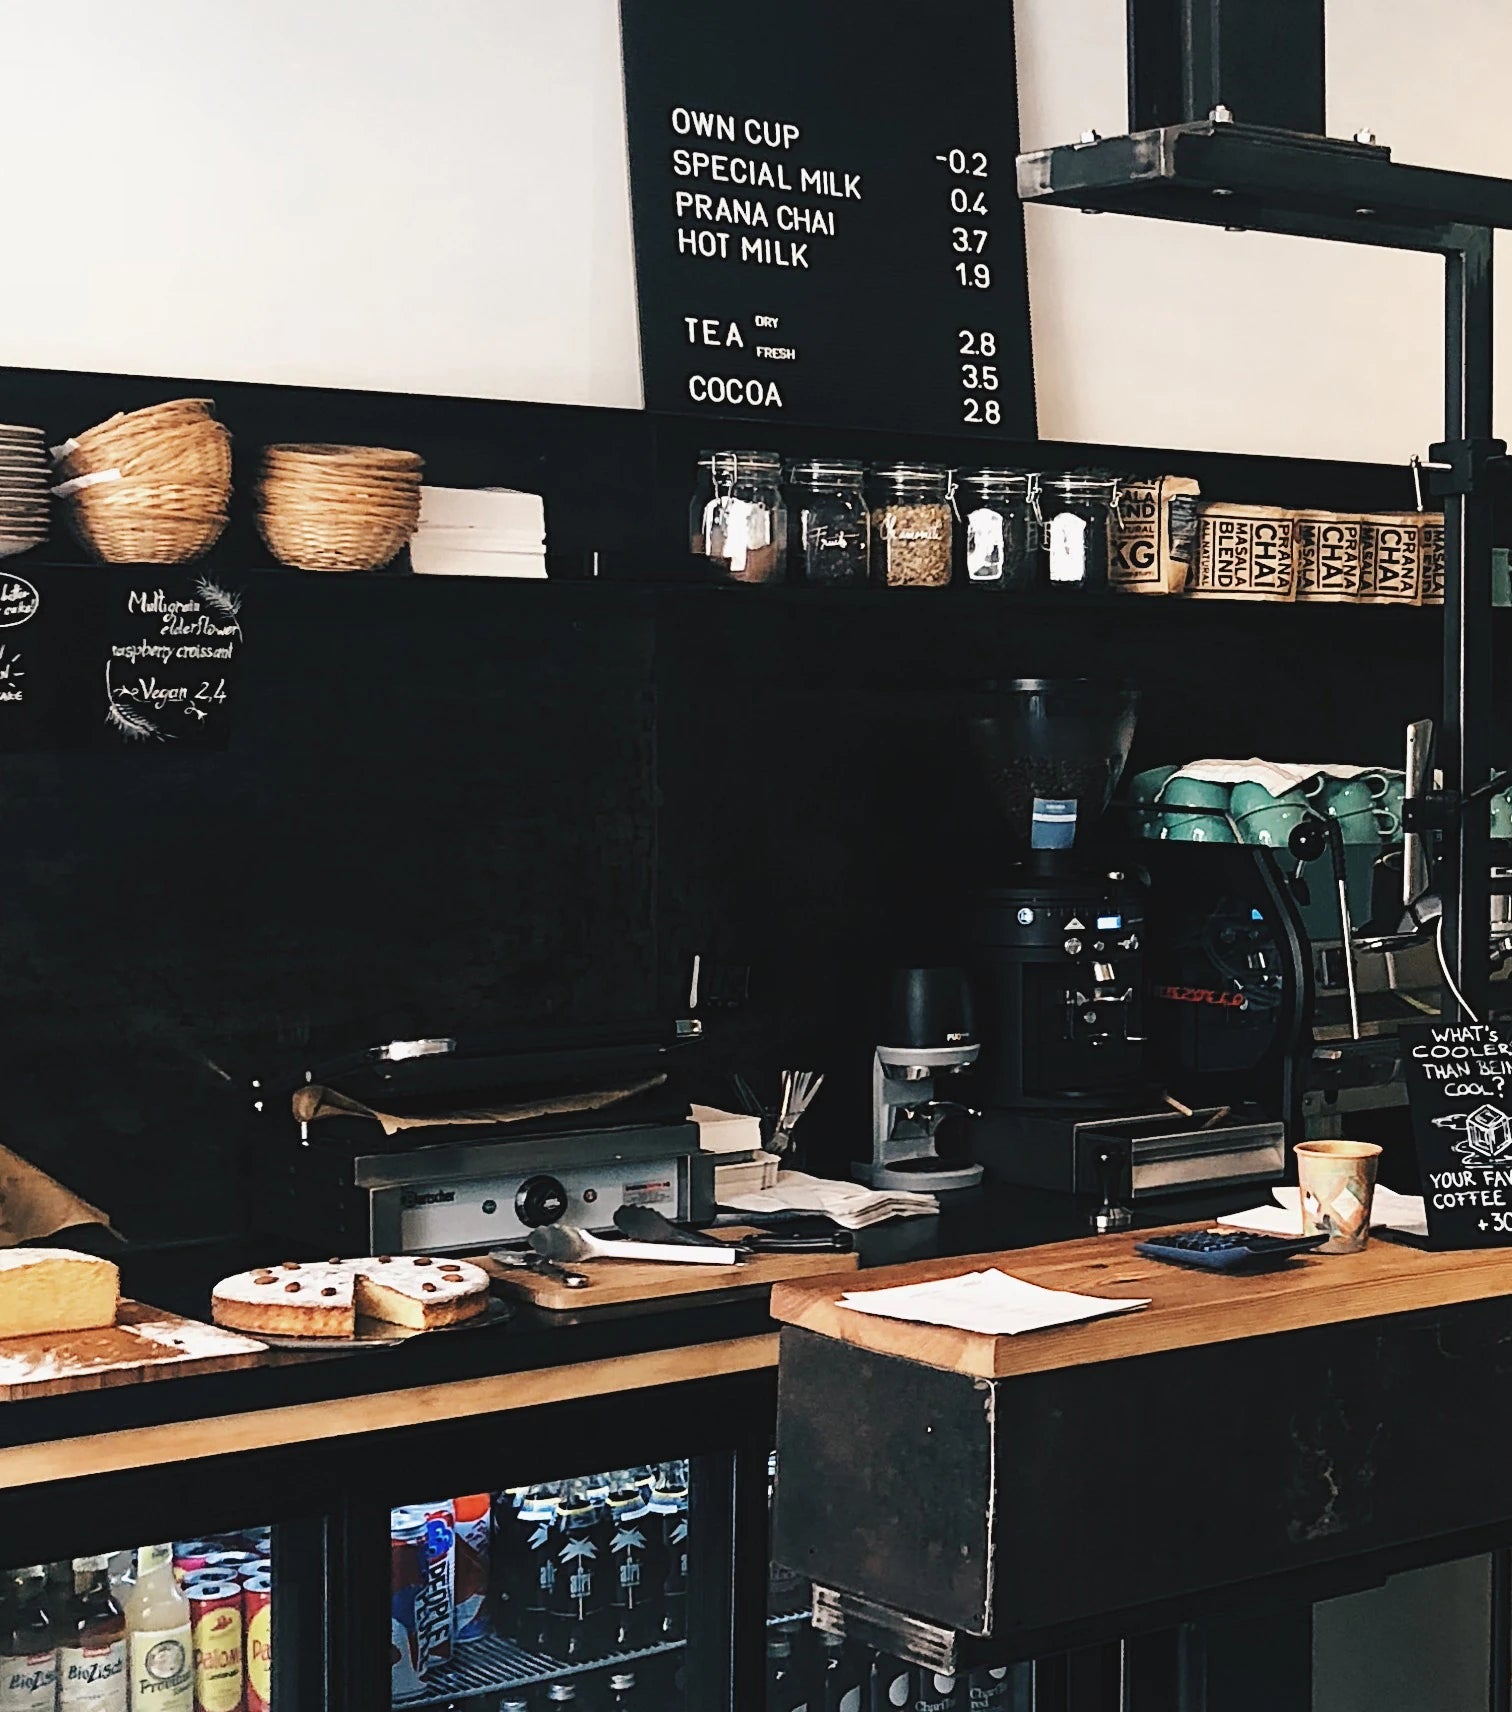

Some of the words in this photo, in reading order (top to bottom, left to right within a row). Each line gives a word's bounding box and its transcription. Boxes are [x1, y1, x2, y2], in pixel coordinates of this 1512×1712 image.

[671, 107, 735, 142] OWN
[744, 118, 800, 150] CUP
[935, 148, 988, 178] -0.2
[673, 149, 793, 191] SPECIAL
[800, 167, 862, 200] MILK
[950, 188, 989, 216] 0.4
[675, 190, 769, 228] PRANA
[776, 204, 835, 236] CHAI
[952, 226, 988, 254] 3.7
[677, 227, 730, 259] HOT
[741, 236, 809, 269] MILK
[955, 262, 991, 289] 1.9
[684, 317, 744, 348] TEA
[754, 315, 779, 329] DRY
[958, 329, 996, 357] 2.8
[688, 374, 783, 408] COCOA
[963, 397, 1001, 425] 2.8
[756, 346, 796, 360] FRESH
[961, 364, 999, 391] 3.5
[1202, 520, 1211, 539] ALL
[1218, 521, 1234, 587] BLEND
[1235, 522, 1248, 587] MASALA
[1254, 523, 1278, 587] CHAI
[1277, 524, 1292, 588] PRANA
[1302, 525, 1316, 589] MASALA
[1321, 526, 1344, 588] CHAI
[1342, 526, 1358, 589] PRANA
[1361, 527, 1375, 591] MASALA
[1379, 529, 1402, 591] CHAI
[1201, 541, 1211, 586] NATURAL
[1400, 530, 1417, 593] PRANA
[1432, 530, 1445, 593] MASALA
[112, 638, 175, 664] raspberry
[176, 642, 233, 659] croissant
[139, 677, 188, 709] Vegan
[194, 678, 227, 704] 2,4
[1412, 1043, 1512, 1059] COOLER
[1422, 1061, 1471, 1080] THAN
[1444, 1075, 1505, 1099] COOL?
[1430, 1170, 1477, 1189] YOUR
[1432, 1190, 1507, 1210] COFFEE
